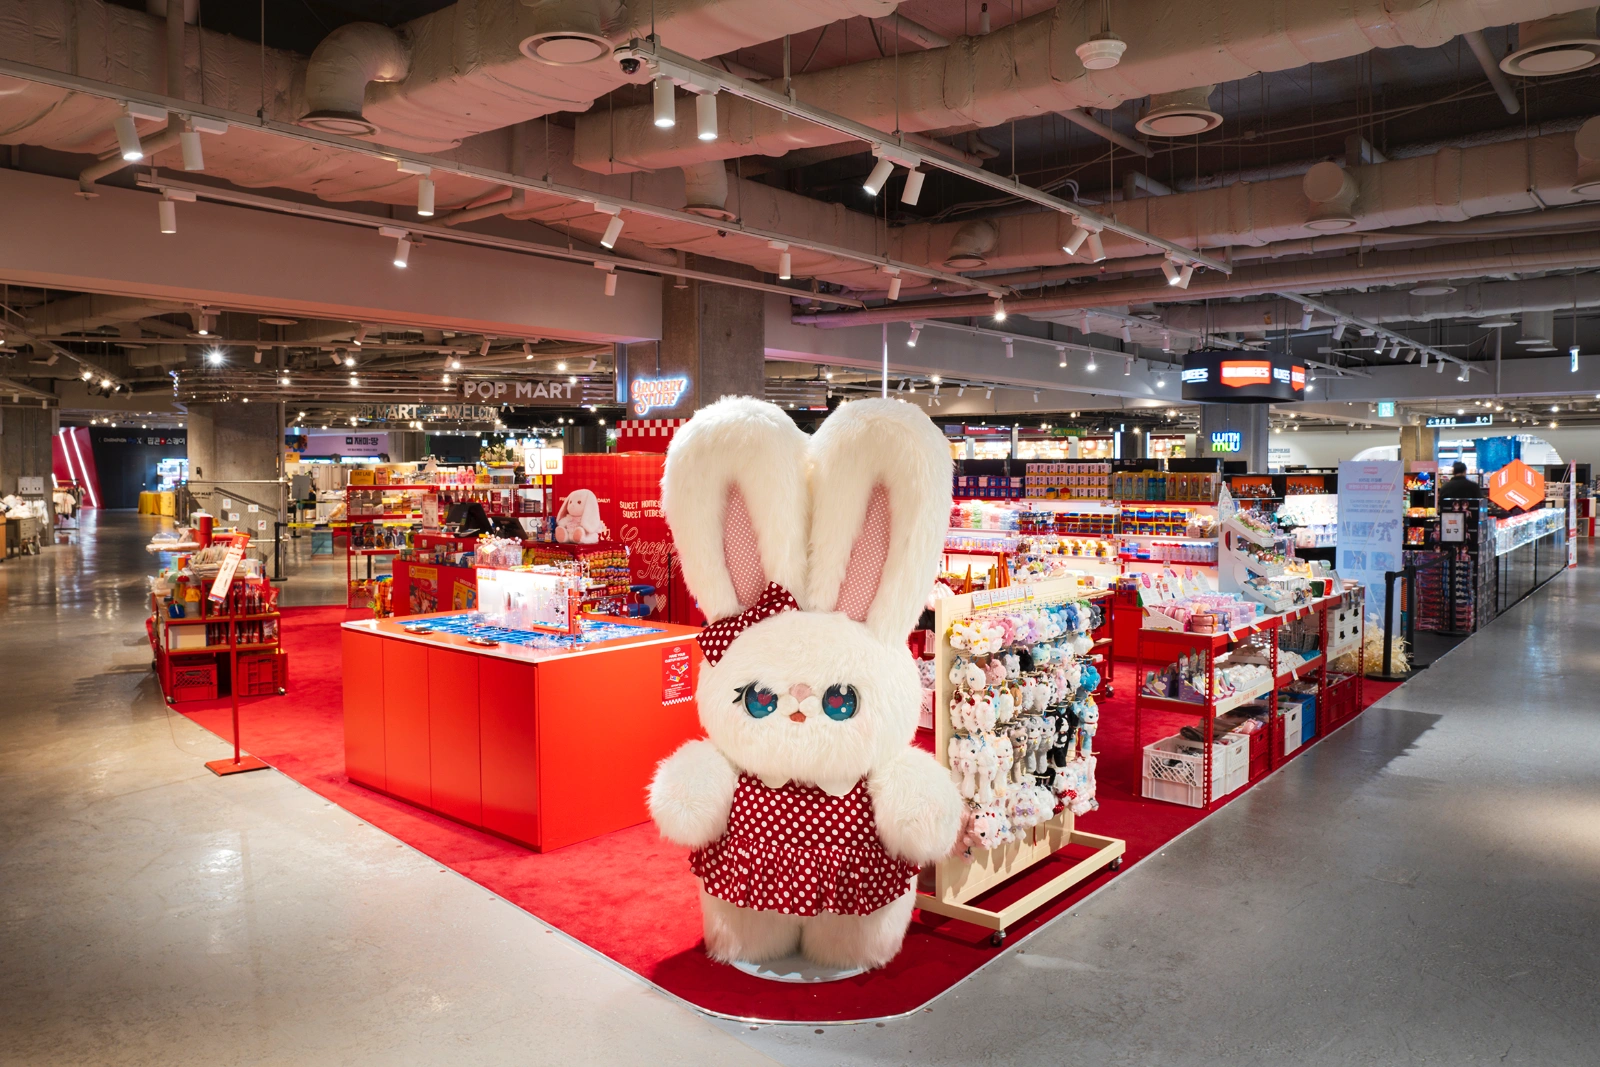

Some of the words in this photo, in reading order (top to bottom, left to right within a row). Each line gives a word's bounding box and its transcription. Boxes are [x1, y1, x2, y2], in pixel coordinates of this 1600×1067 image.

[464, 381, 507, 398] POP
[516, 381, 573, 399] MART
[630, 379, 684, 397] GROCERY
[634, 391, 677, 414] STUFF
[376, 404, 420, 419] MART
[620, 501, 638, 509] SWEET
[622, 510, 641, 518] SWEET
